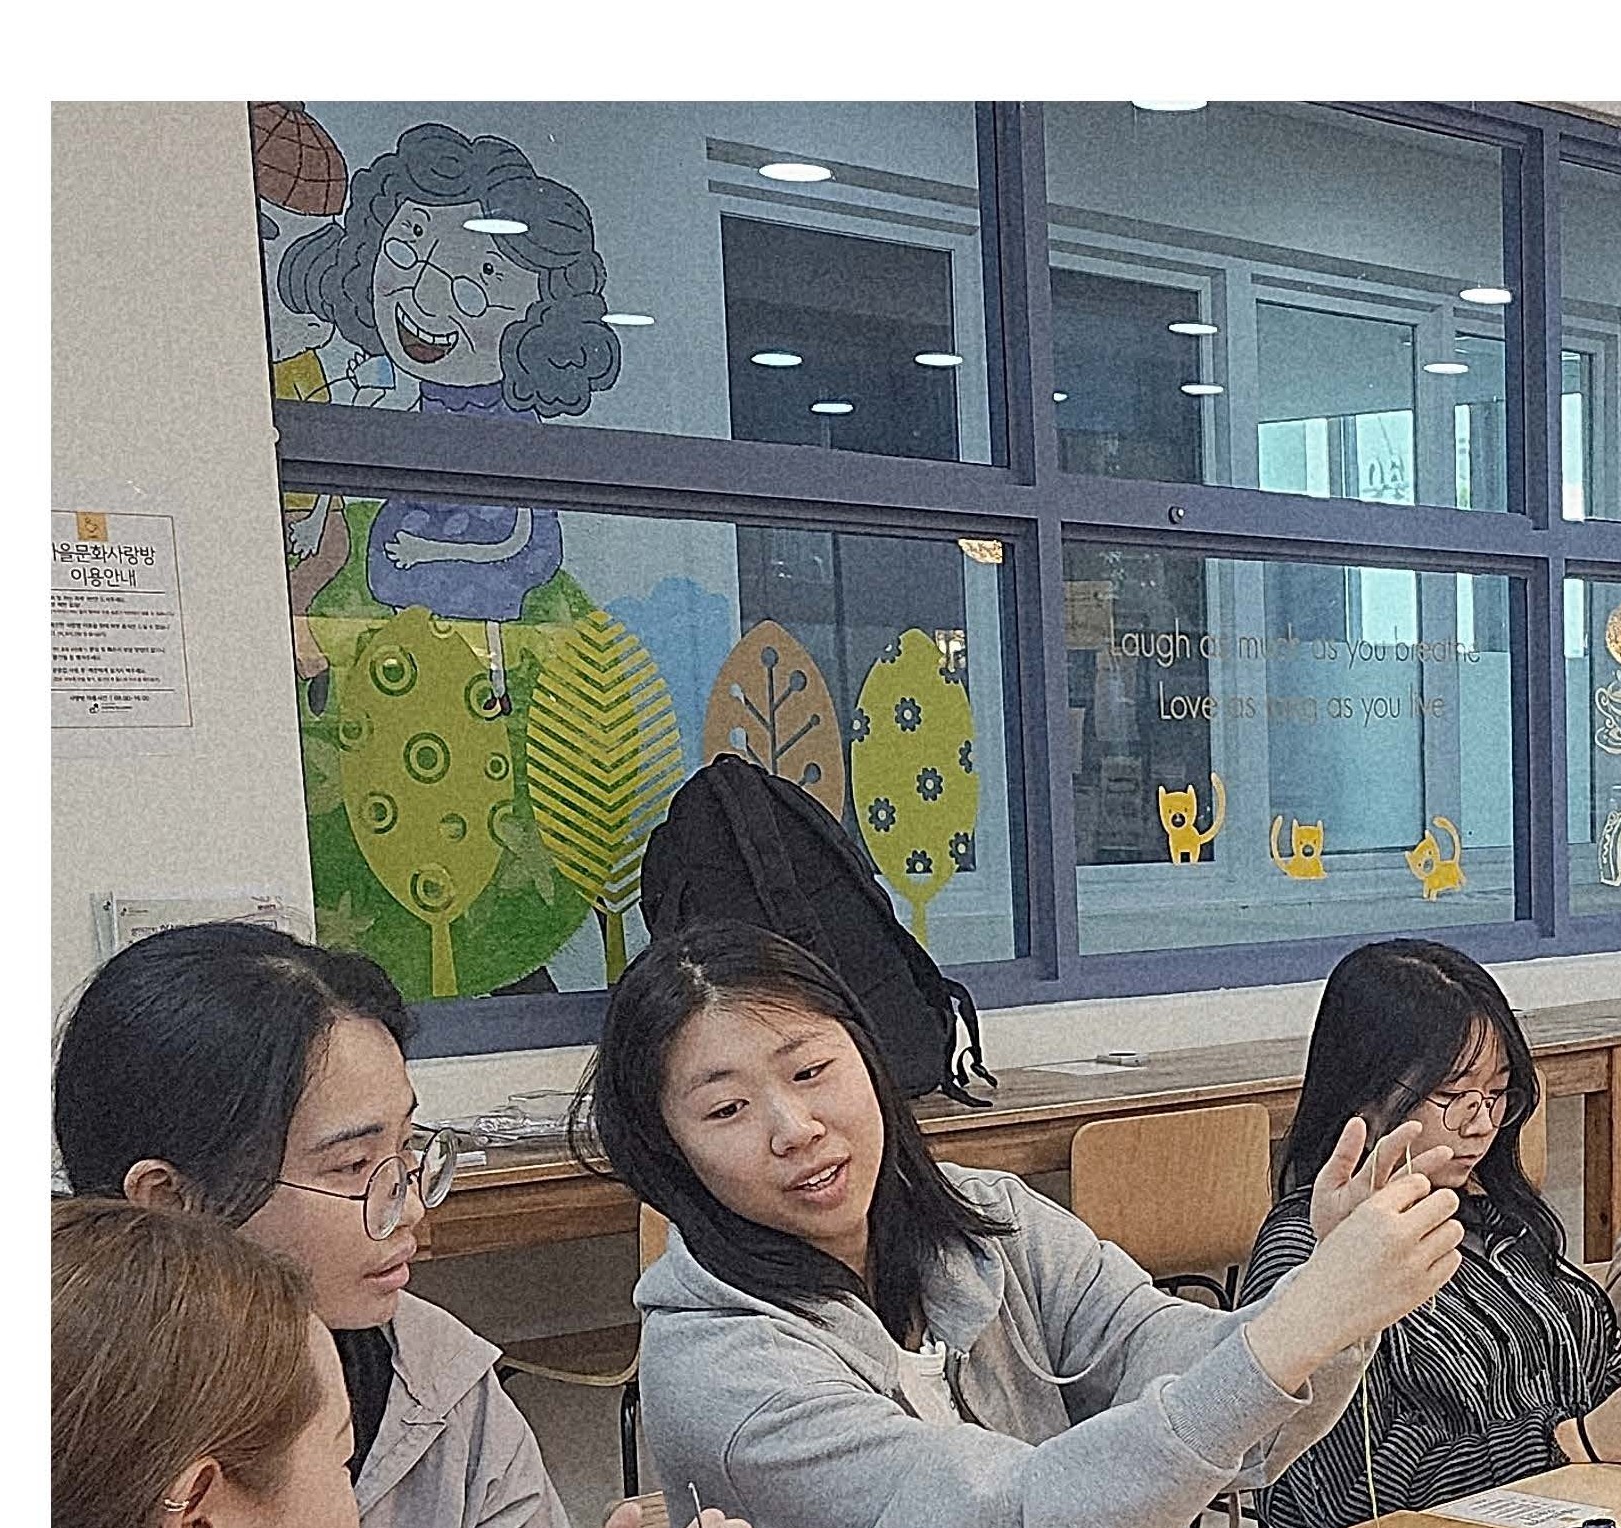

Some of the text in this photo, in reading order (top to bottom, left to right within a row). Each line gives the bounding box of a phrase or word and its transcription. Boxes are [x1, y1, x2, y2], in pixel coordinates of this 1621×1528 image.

[71, 567, 137, 588] 이용안내
[1110, 617, 1190, 668] Laugh
[1346, 641, 1387, 670] you
[1159, 681, 1217, 721] Love
[1359, 697, 1402, 728] you
